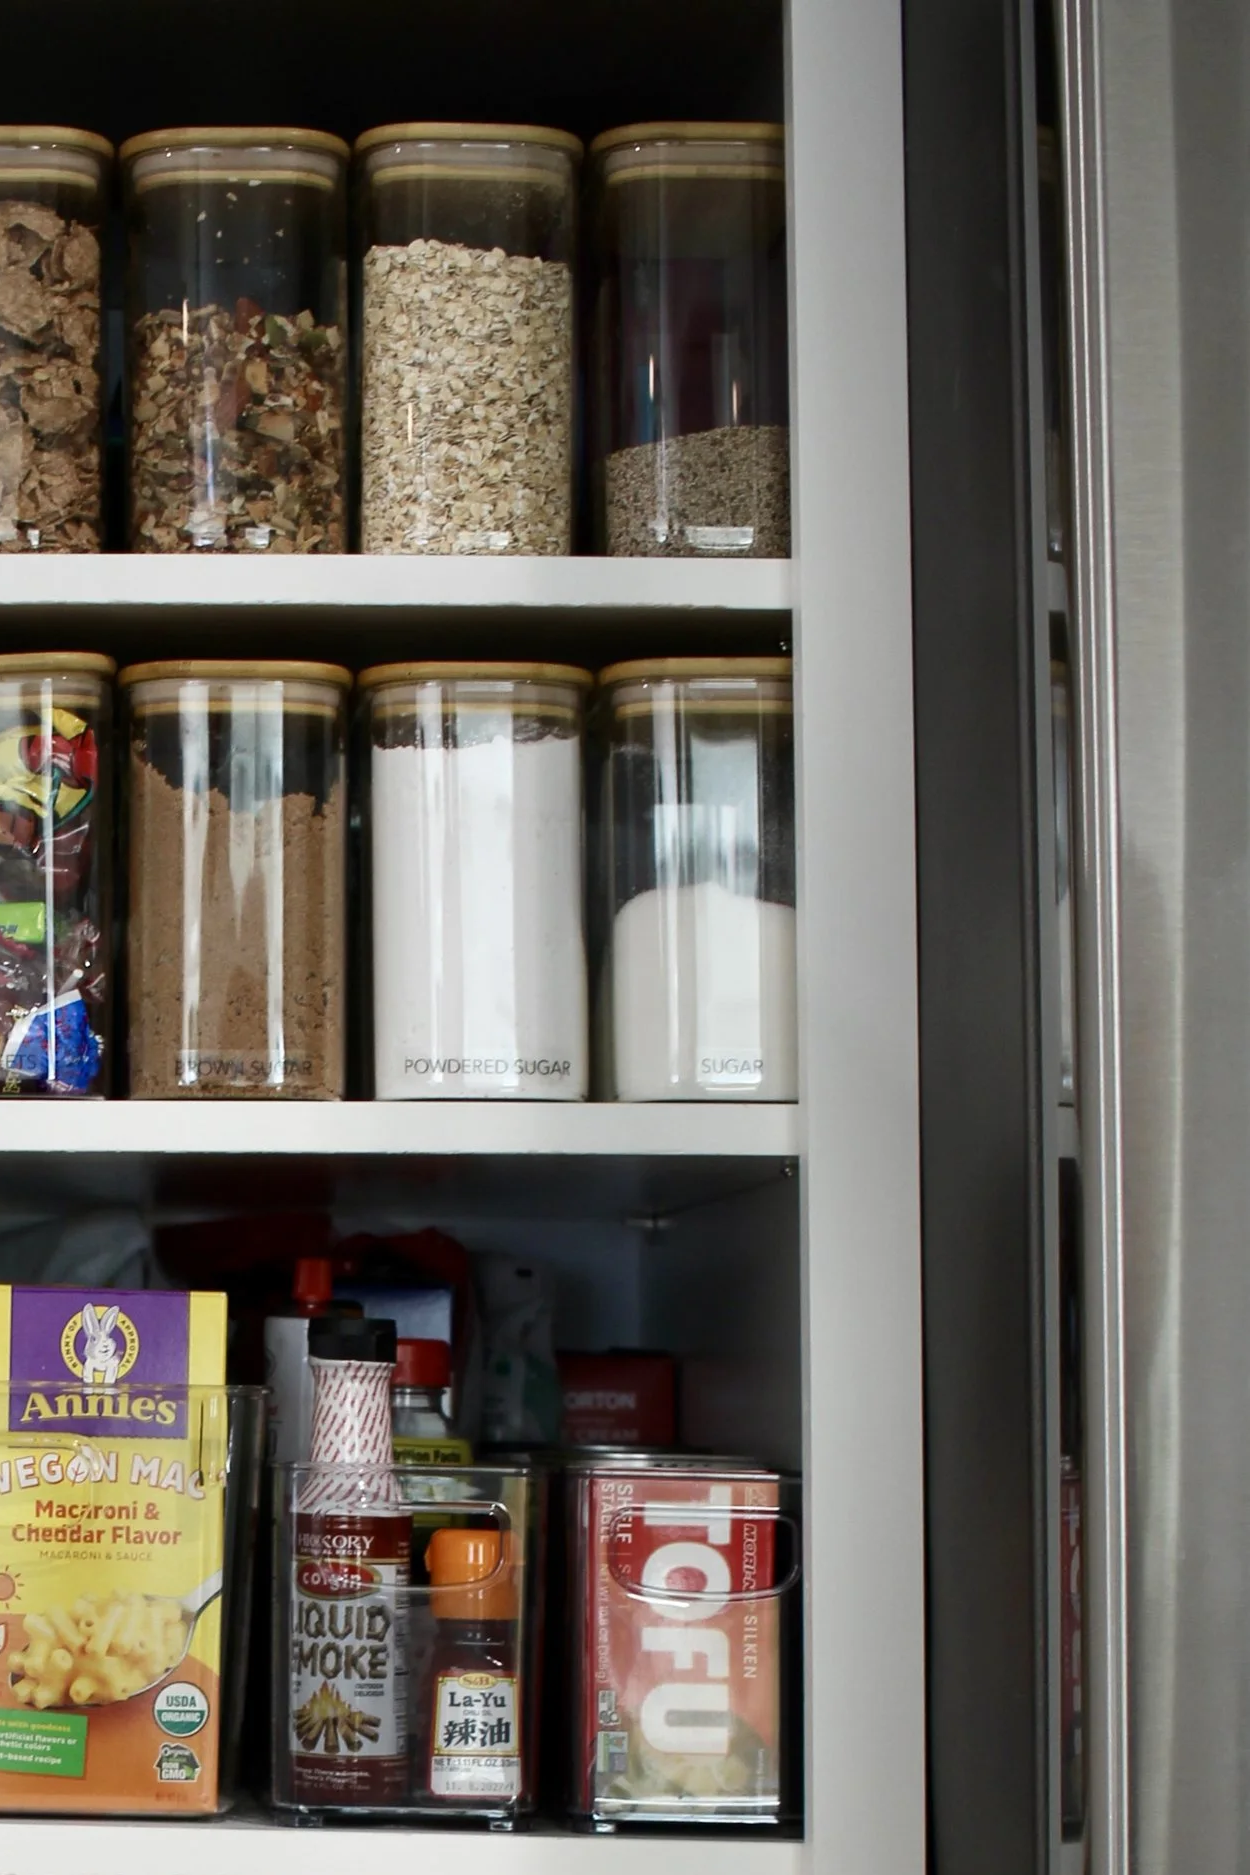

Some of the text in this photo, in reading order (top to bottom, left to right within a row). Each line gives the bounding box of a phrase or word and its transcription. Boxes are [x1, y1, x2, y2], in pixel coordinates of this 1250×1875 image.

[404, 1058, 571, 1076] POWDERED SUGAR
[701, 1057, 764, 1075] SUGAR
[64, 1320, 78, 1369] BUNNY OF
[120, 1319, 137, 1369] APPROVAL
[20, 1391, 177, 1425] Annie's
[130, 1454, 207, 1500] MAC
[35, 1500, 160, 1521] Macaroni &
[12, 1523, 182, 1545] Cheddar Flavor
[39, 1550, 102, 1561] MACARONI
[116, 1551, 153, 1561] SAUCE
[743, 1523, 758, 1680] MORI-N SILKEN
[640, 1484, 733, 1755] TOFU
[165, 1696, 198, 1708] USDA
[448, 1691, 507, 1708] La-Yu
[161, 1711, 202, 1723] ORGANIC
[35, 1734, 66, 1744] flavors
[443, 1717, 512, 1749] 辣油
[23, 1742, 52, 1752] colors
[35, 1755, 62, 1765] recipe
[162, 1769, 187, 1780] GMO
